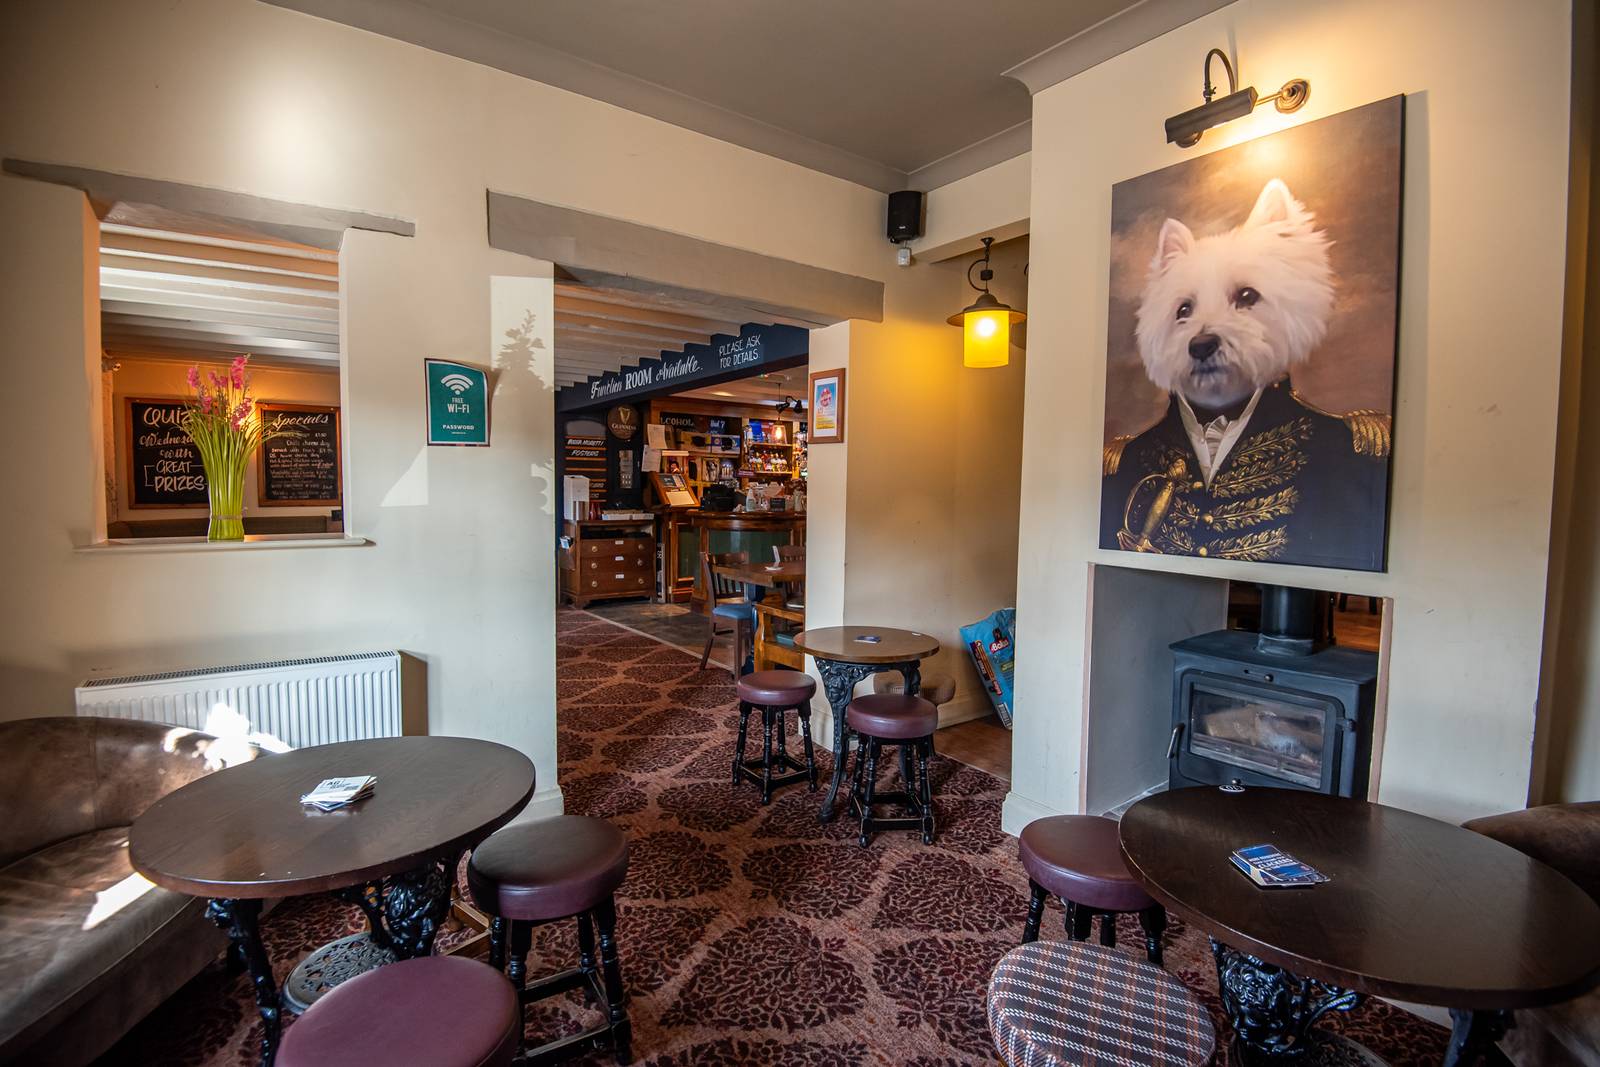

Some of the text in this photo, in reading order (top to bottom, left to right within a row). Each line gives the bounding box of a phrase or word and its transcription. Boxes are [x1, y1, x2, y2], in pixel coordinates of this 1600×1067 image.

[719, 334, 761, 356] PLEASE ASK
[720, 358, 732, 369] FOR
[625, 366, 652, 390] ROOM
[447, 404, 470, 413] WI-FI
[272, 412, 329, 431] Specials
[611, 423, 637, 431] GUINNESS
[156, 460, 192, 474] GREAT
[154, 475, 205, 493] PRIZES
